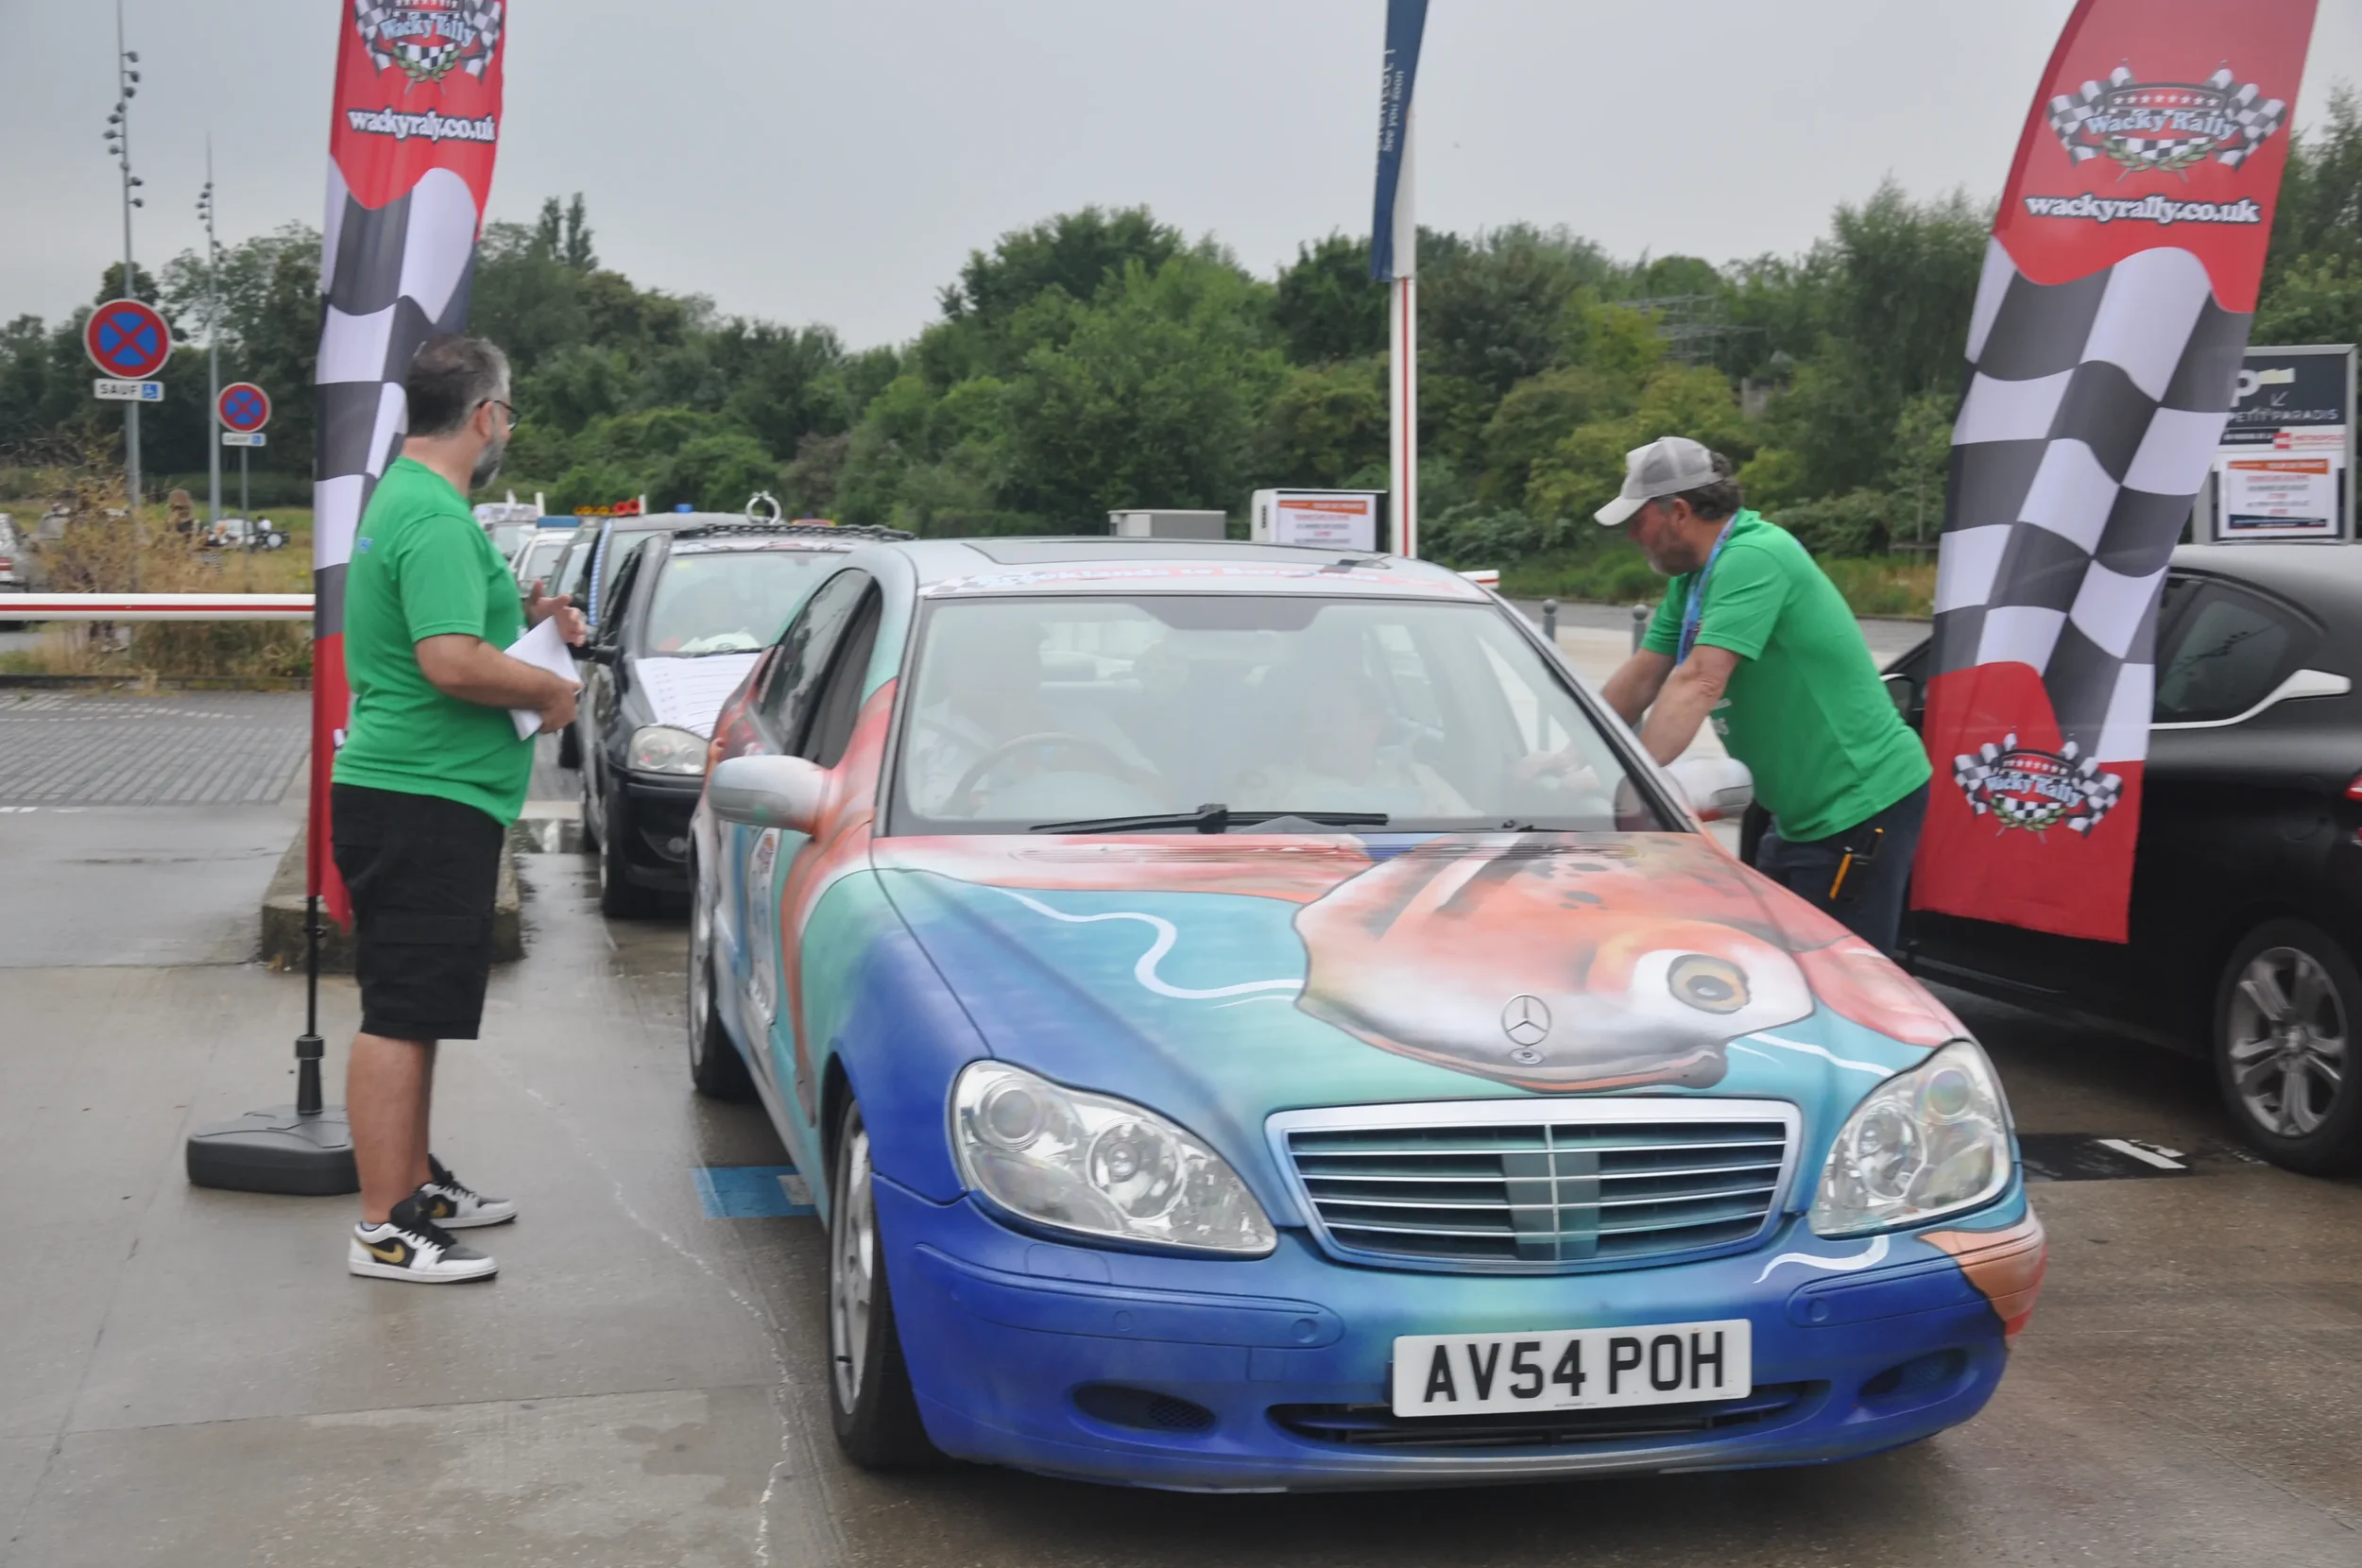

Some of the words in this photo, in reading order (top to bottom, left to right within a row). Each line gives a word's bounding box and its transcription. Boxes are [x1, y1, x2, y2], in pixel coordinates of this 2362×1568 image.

[2084, 109, 2166, 135] Wacky
[2169, 111, 2239, 141] Rally
[2024, 192, 2261, 224] wackyrally.co.uk
[99, 383, 139, 396] SAUF
[2271, 408, 2339, 421] PARADIS
[1985, 771, 2033, 794] Wacky
[2034, 775, 2084, 808] Rally
[1422, 1338, 1586, 1403] AV54
[1608, 1330, 1724, 1395] POH
